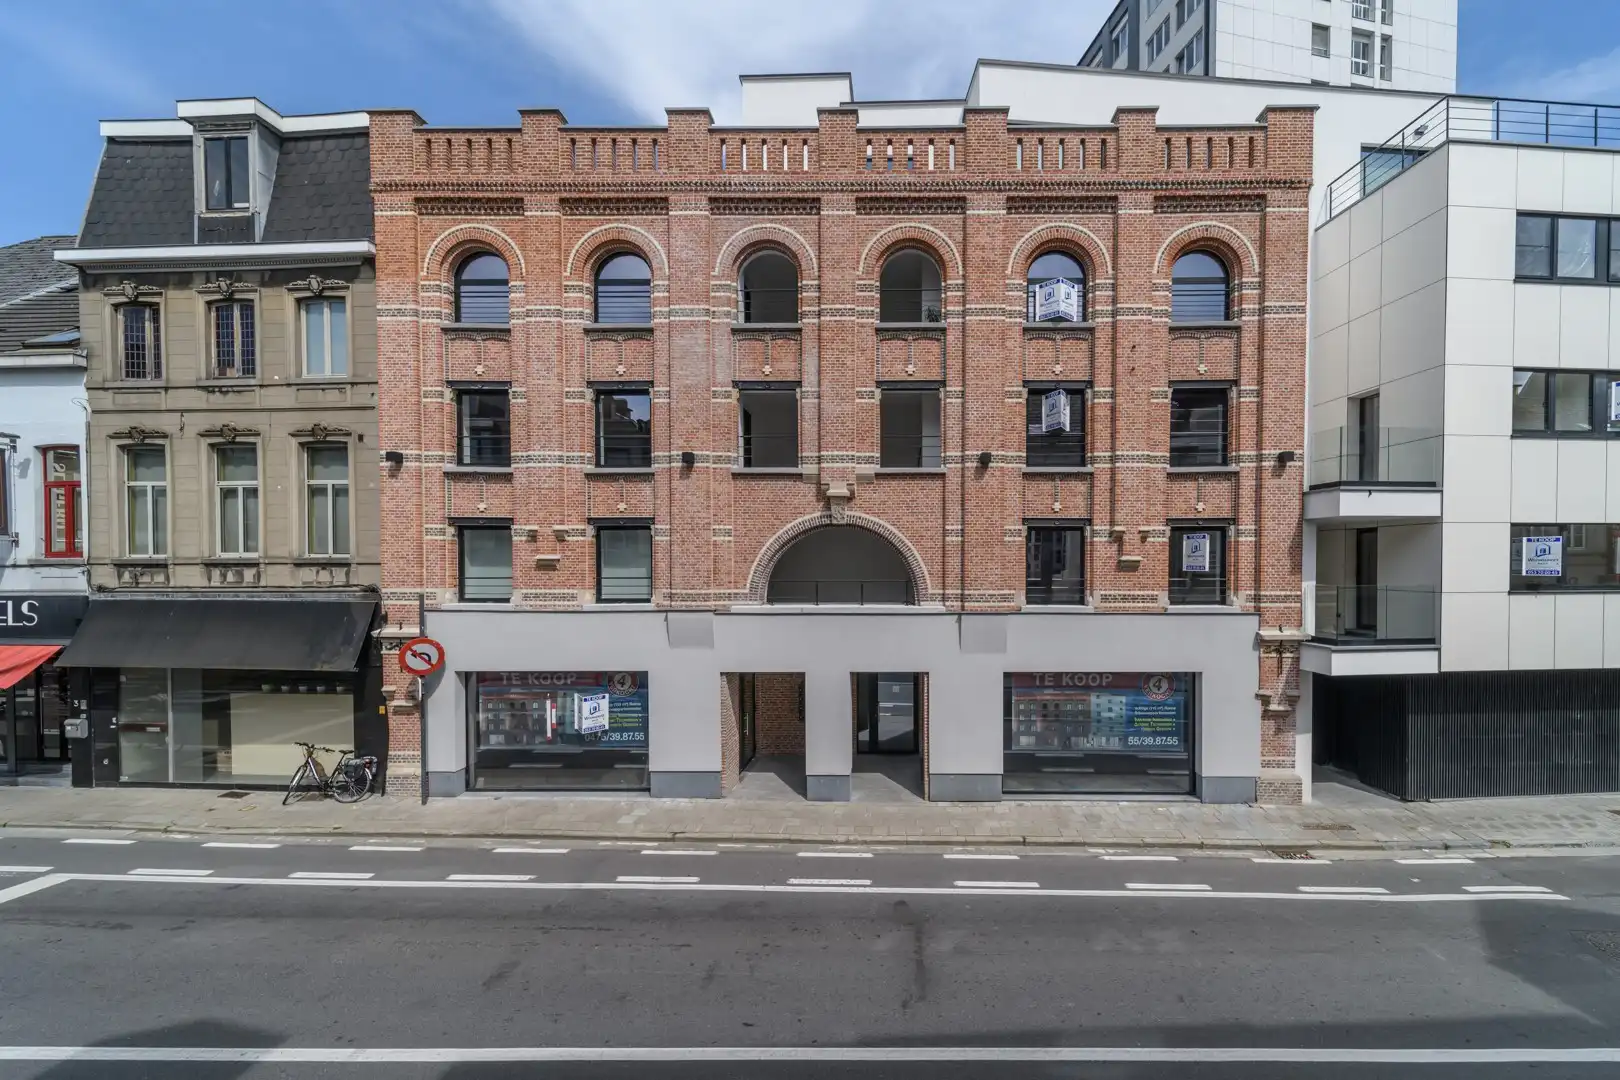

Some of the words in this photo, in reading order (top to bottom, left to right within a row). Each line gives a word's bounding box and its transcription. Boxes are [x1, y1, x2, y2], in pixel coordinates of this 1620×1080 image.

[500, 672, 521, 685] TE
[528, 672, 577, 685] KOOP
[617, 674, 627, 688] 4
[1033, 672, 1054, 686] TE
[1062, 672, 1113, 686] KOOP
[1153, 677, 1163, 691] 4
